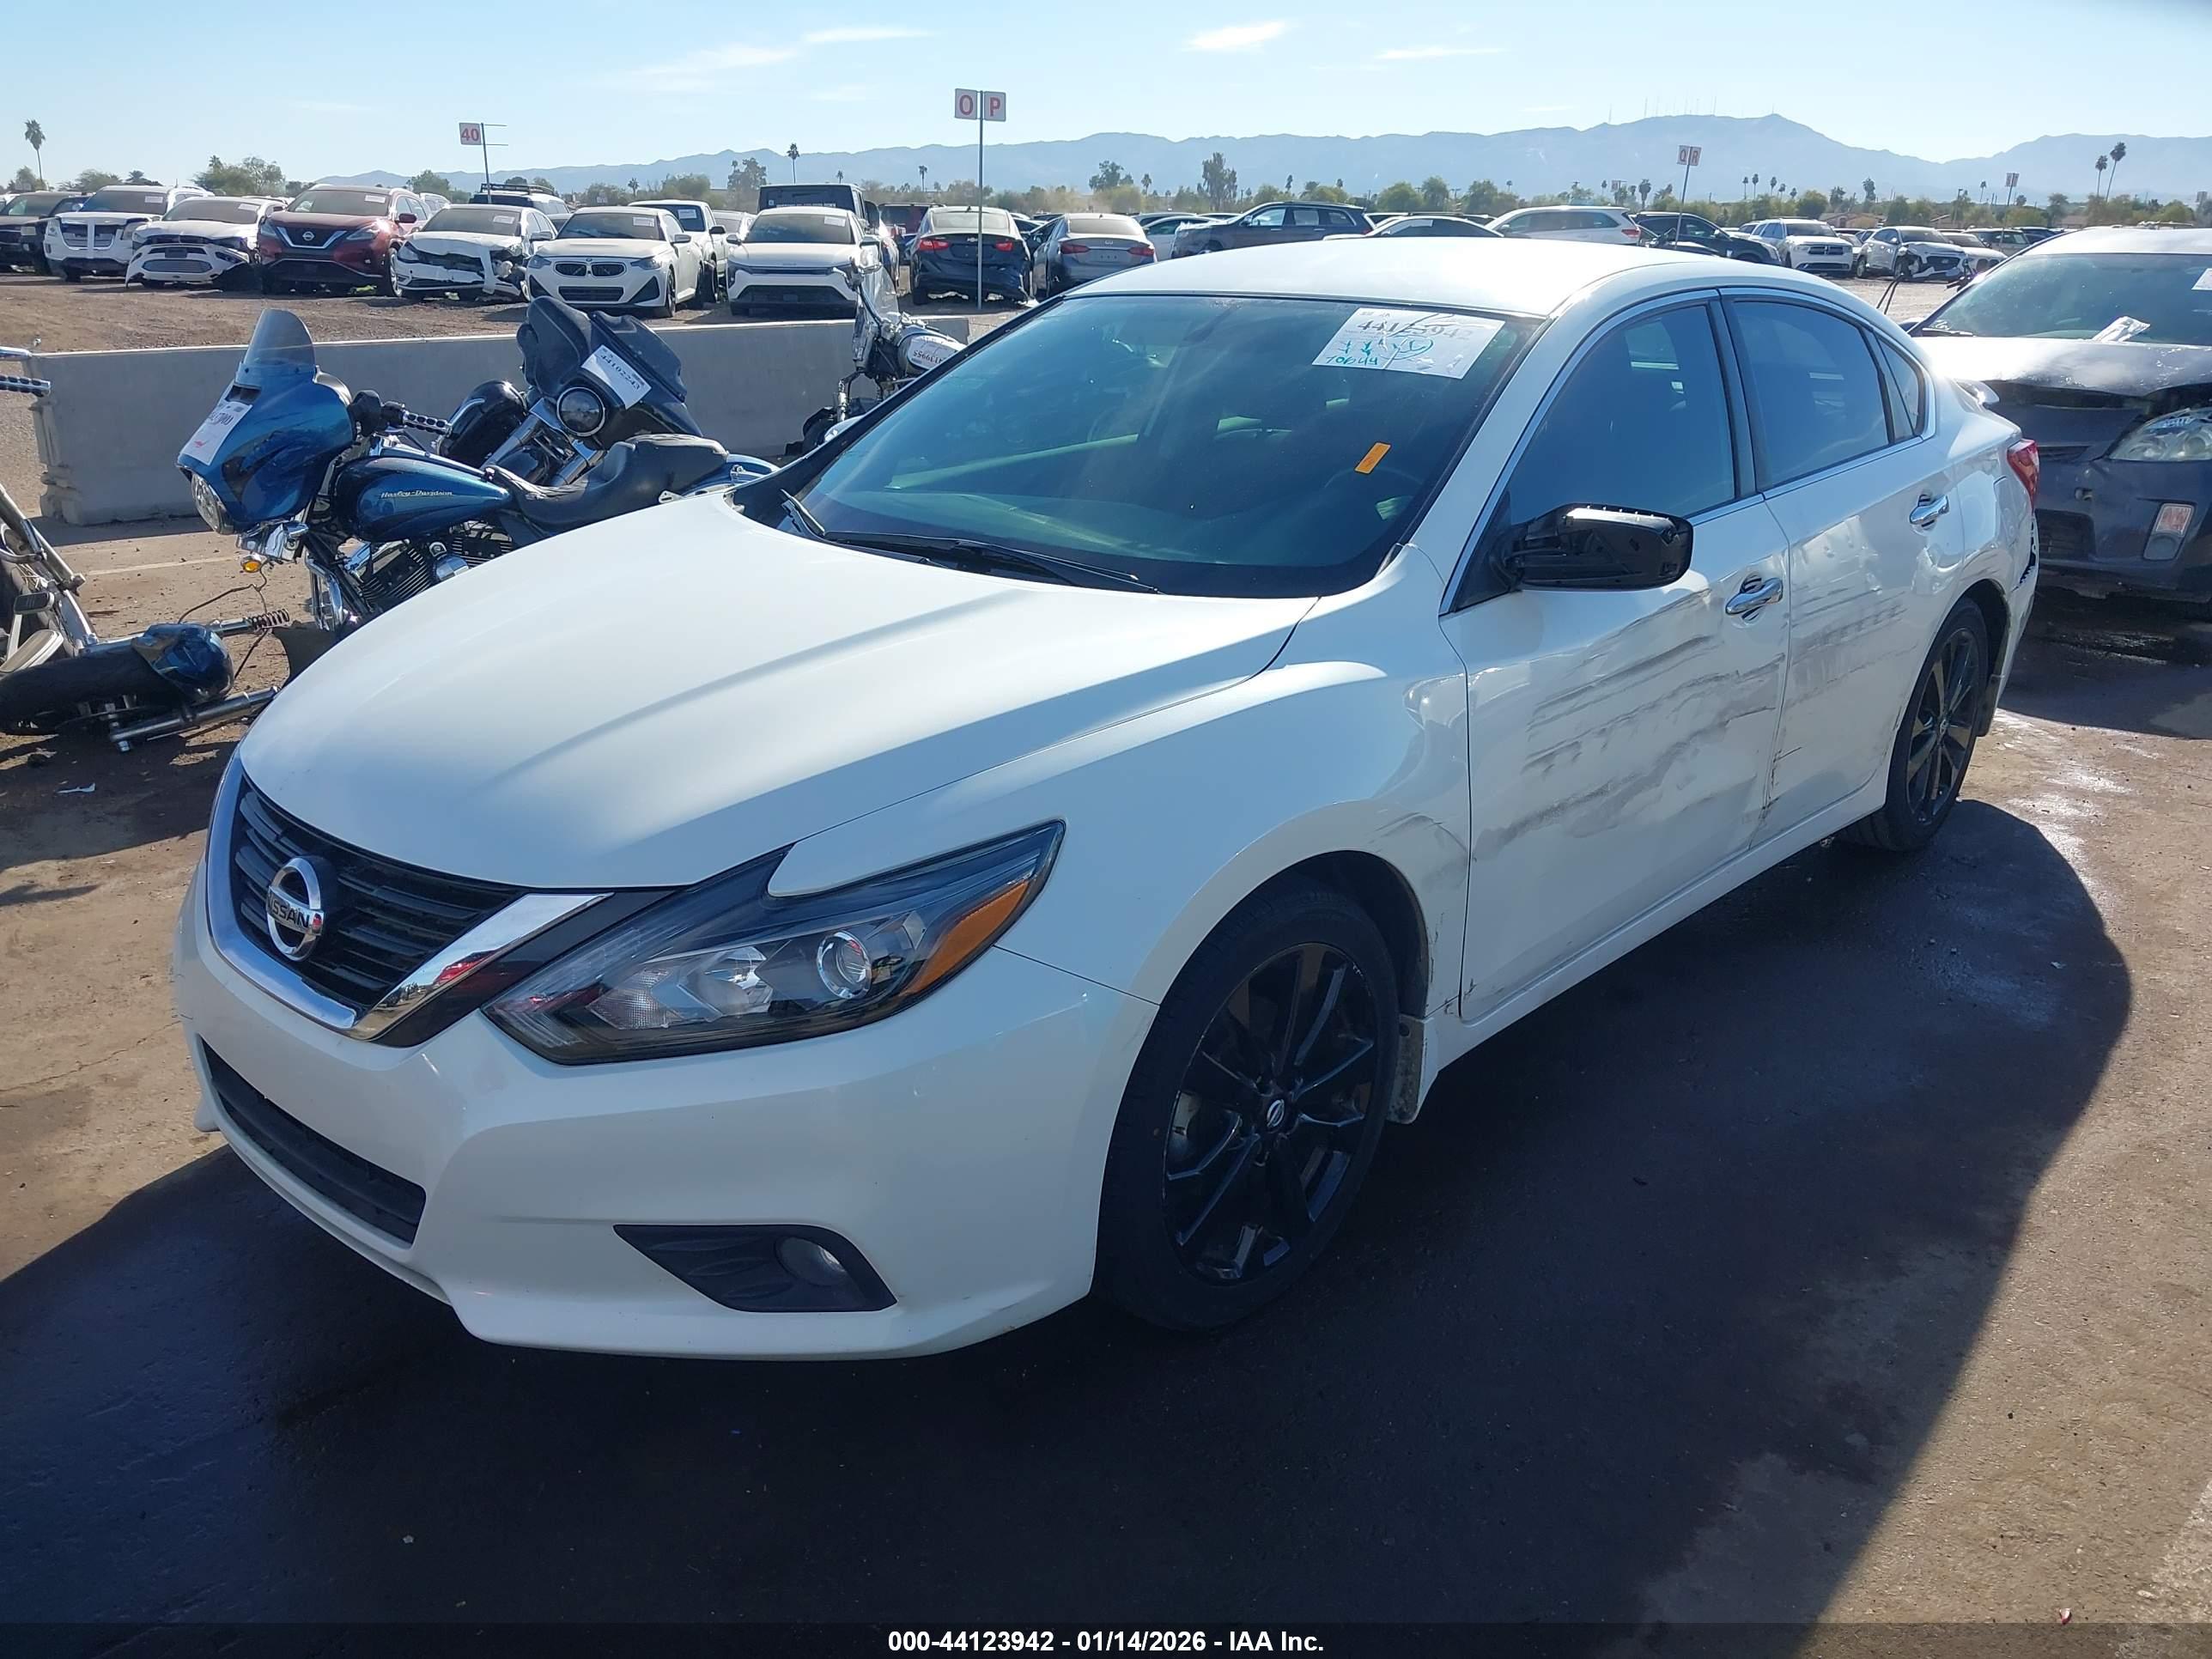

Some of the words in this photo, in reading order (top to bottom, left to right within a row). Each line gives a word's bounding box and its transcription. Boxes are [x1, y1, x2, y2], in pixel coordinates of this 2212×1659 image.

[959, 94, 973, 116] O
[989, 96, 1000, 117] P
[461, 128, 479, 142] 40
[380, 489, 453, 499] Harley-Davidson
[267, 890, 310, 928] NISSAN
